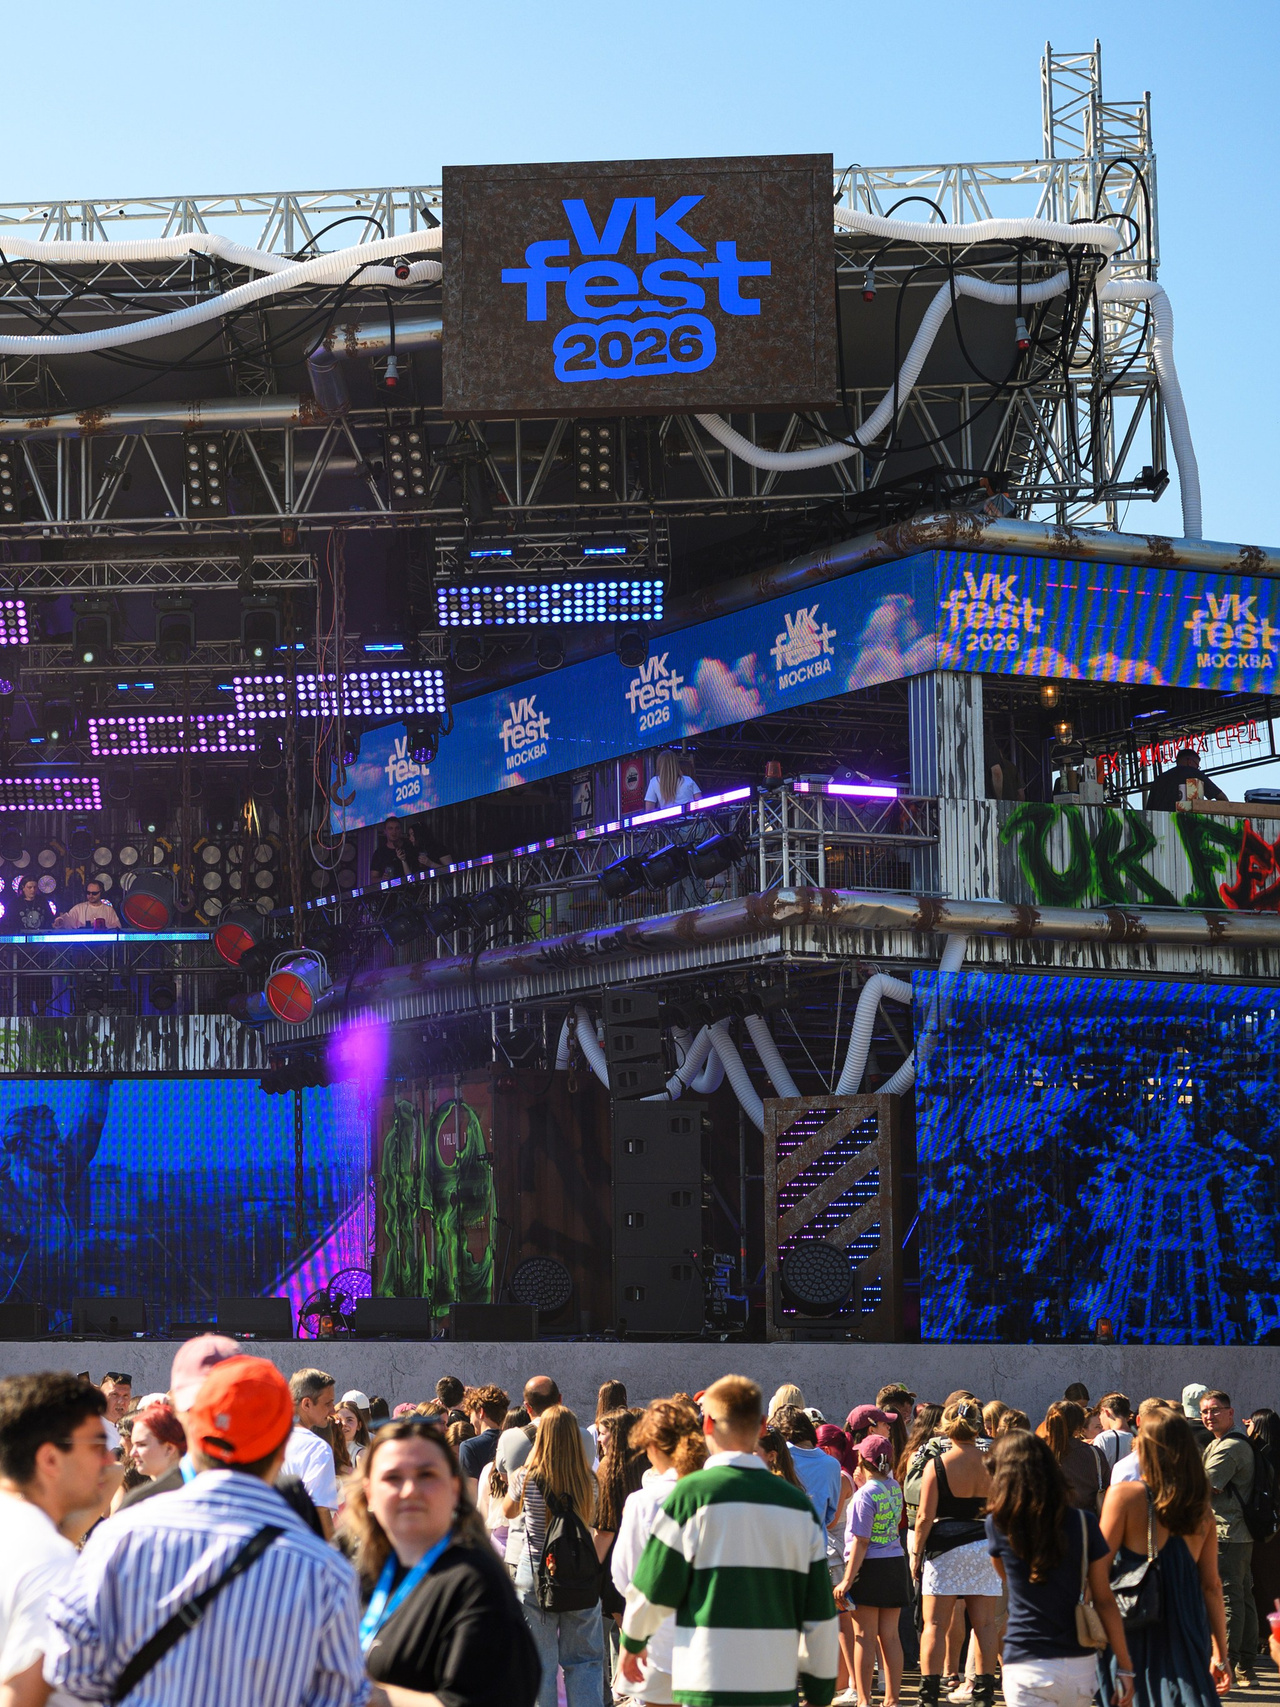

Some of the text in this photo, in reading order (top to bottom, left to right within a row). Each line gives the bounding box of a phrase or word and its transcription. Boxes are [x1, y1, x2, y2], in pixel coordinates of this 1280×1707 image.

[562, 195, 708, 255] VK
[501, 239, 772, 321] fest
[562, 324, 705, 372] 2026
[963, 571, 1020, 602] VK
[940, 590, 1044, 633] fest
[1205, 592, 1258, 623] VK
[966, 633, 1020, 651] 2026
[1184, 610, 1280, 652] fest
[639, 652, 670, 683] VK
[778, 658, 832, 690] МОСКВА
[1197, 653, 1273, 668] МОСКВА
[625, 669, 684, 714] fest
[509, 694, 538, 724] VK
[639, 705, 670, 731] 2026
[499, 711, 550, 753] fest
[506, 742, 548, 770] МОСКВА
[395, 779, 421, 802] 2026
